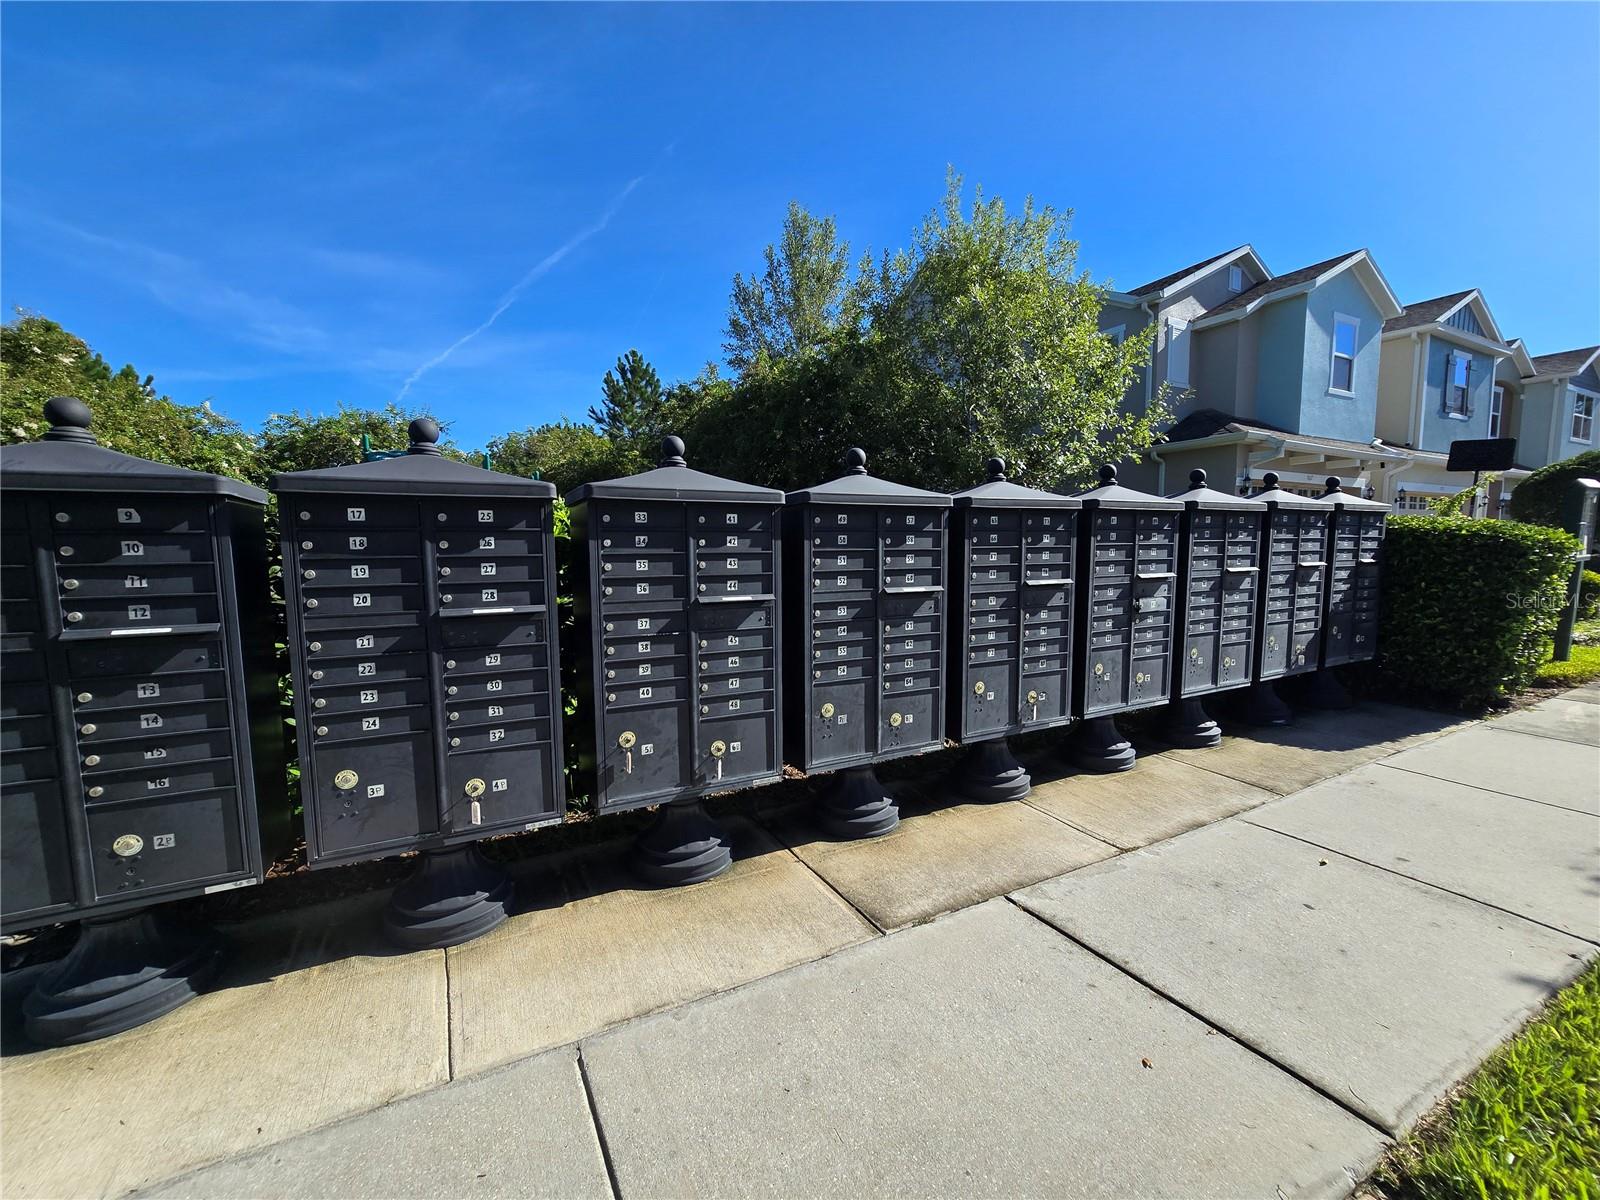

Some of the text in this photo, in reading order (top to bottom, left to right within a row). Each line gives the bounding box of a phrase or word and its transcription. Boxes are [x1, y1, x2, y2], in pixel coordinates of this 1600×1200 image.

[124, 510, 134, 521] 9
[350, 510, 363, 520] 17
[479, 512, 492, 521] 25
[635, 513, 647, 521] 33
[727, 515, 736, 523] 41
[351, 538, 366, 549] 18
[482, 539, 493, 548] 26
[636, 537, 646, 546] 34
[727, 537, 736, 546] 42
[124, 542, 140, 554] 10
[482, 565, 494, 574] 27
[637, 561, 647, 569] 35
[353, 567, 367, 577] 19
[128, 576, 144, 587] 11
[638, 584, 648, 593] 36
[354, 595, 368, 605] 20
[483, 591, 496, 600] 28
[131, 607, 148, 618] 12
[638, 620, 649, 628] 37
[358, 637, 372, 648] 21
[728, 637, 738, 645] 45
[640, 643, 650, 651] 38
[487, 655, 499, 665] 29
[729, 658, 738, 666] 46
[360, 664, 374, 675] 22
[640, 666, 650, 674] 39
[488, 680, 500, 690] 30
[729, 680, 738, 688] 47
[139, 685, 157, 696] 13
[640, 689, 650, 697] 40
[362, 692, 376, 702] 23
[490, 706, 502, 716] 31
[143, 715, 160, 727] 14
[364, 718, 378, 729] 24
[491, 730, 504, 740] 32
[368, 786, 382, 797] 3P
